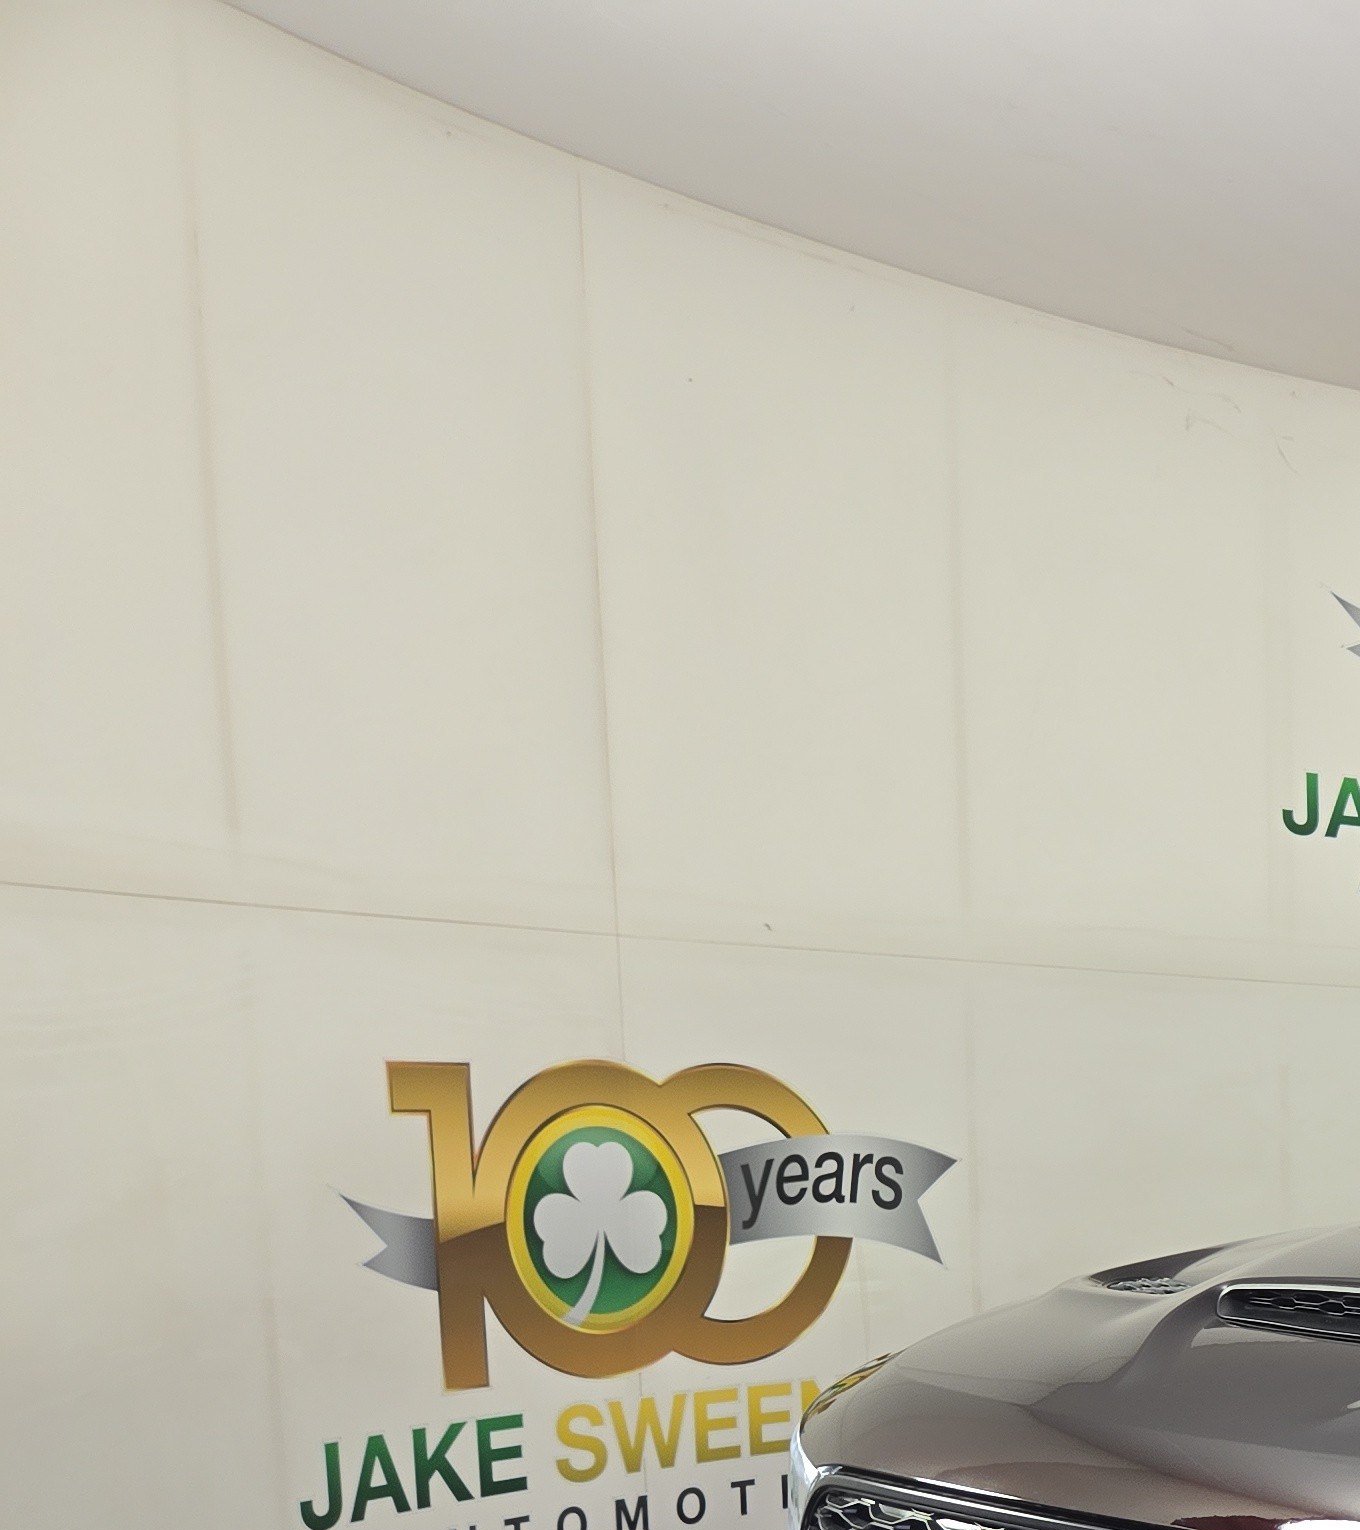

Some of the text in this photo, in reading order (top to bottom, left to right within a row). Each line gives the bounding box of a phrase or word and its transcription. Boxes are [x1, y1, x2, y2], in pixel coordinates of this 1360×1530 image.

[386, 1059, 853, 1390] 100
[740, 1151, 905, 1230] years
[555, 1380, 820, 1484] SWEE
